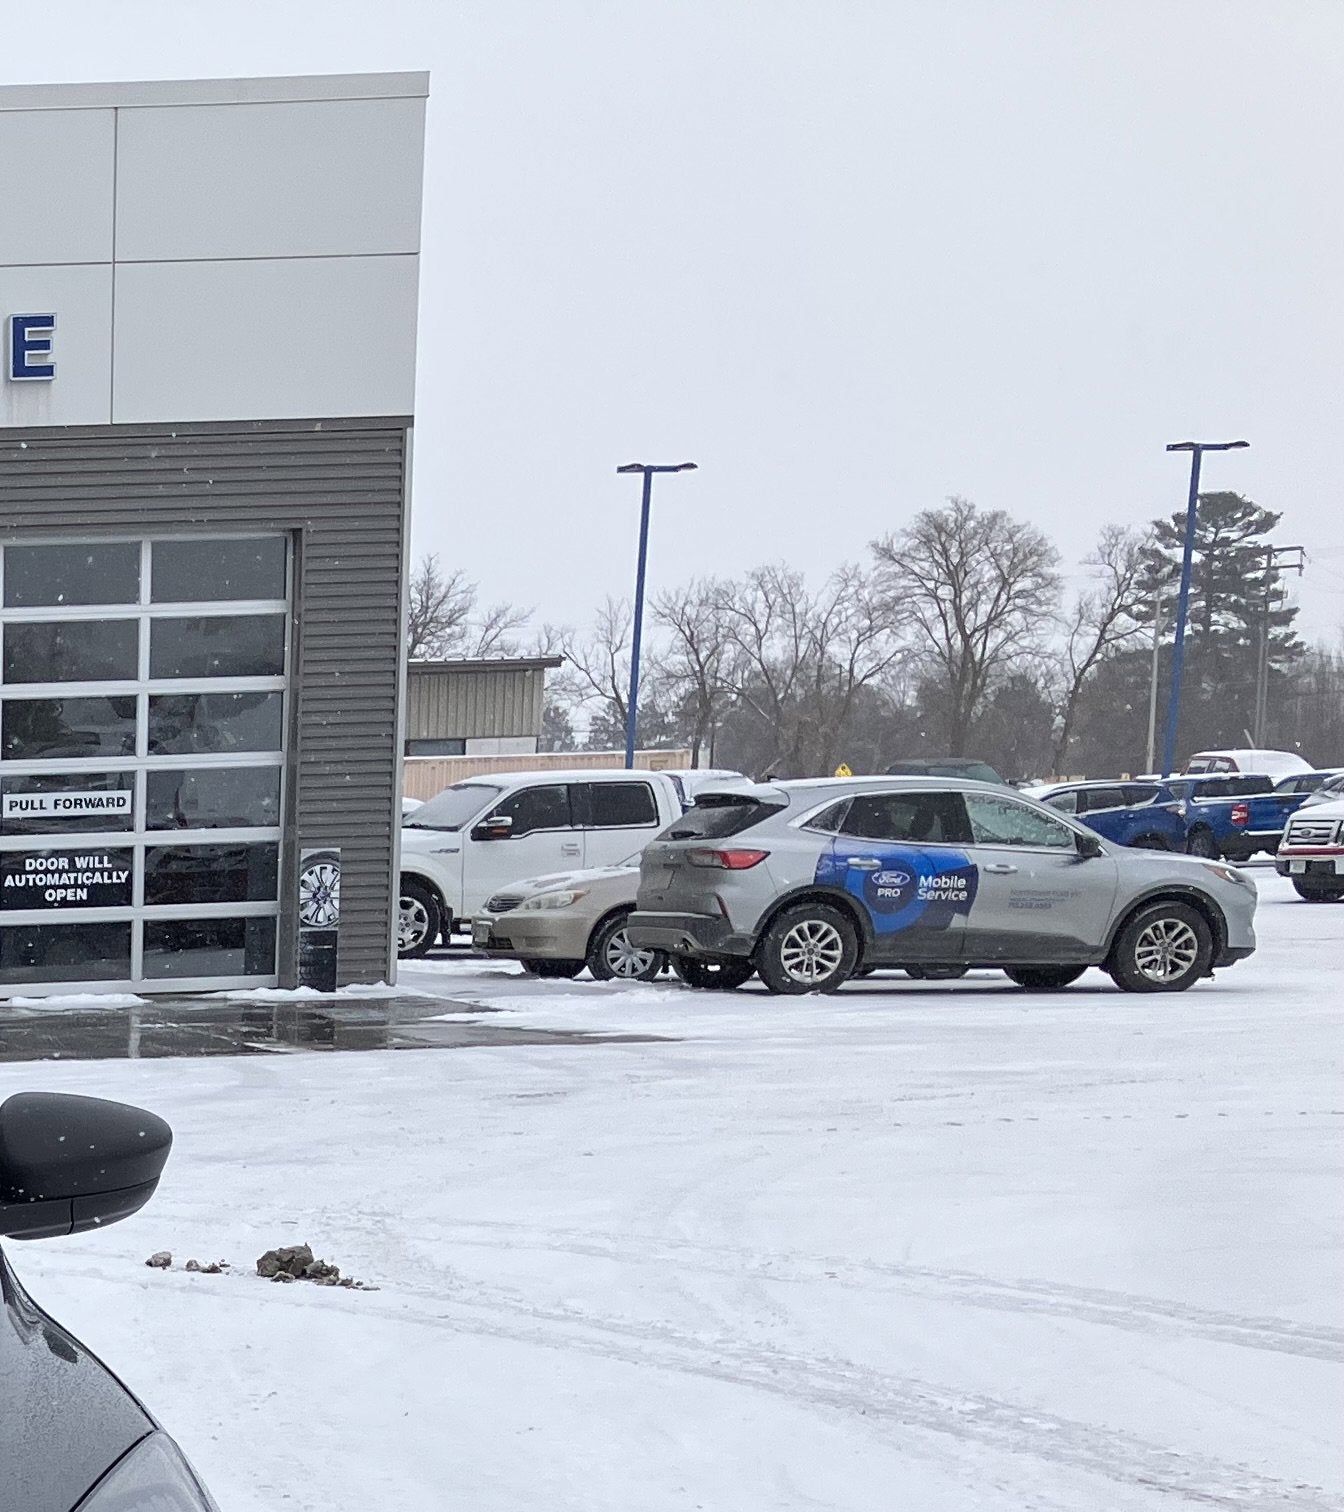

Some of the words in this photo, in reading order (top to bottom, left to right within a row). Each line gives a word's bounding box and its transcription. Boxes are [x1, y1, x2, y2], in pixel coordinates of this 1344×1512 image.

[9, 799, 47, 811] PULL
[53, 796, 127, 810] FORWARD
[25, 857, 69, 871] DOOR
[74, 855, 113, 869] WILL
[3, 870, 129, 887] AUTOMATICALLY
[919, 875, 967, 889] Mobile
[44, 887, 88, 901] OPEN
[877, 887, 901, 898] PRO
[917, 888, 968, 901] Service
